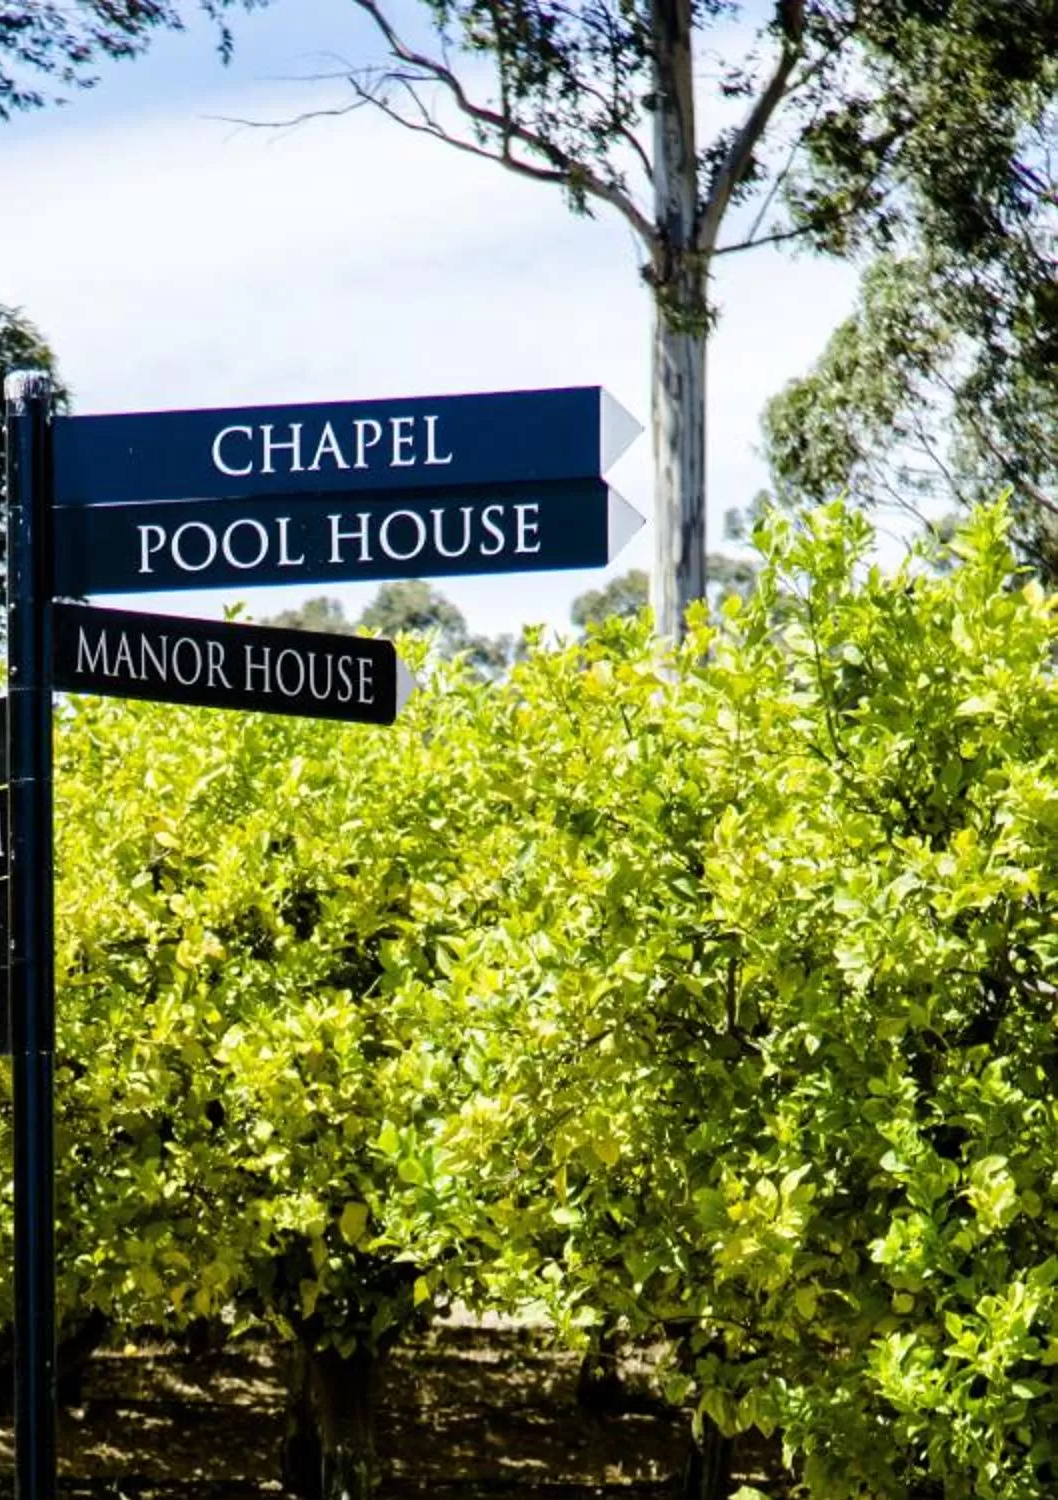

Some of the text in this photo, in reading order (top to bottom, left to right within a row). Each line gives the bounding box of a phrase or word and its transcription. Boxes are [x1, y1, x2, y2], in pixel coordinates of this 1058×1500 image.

[211, 415, 454, 476] CHAPEL
[137, 503, 541, 574] POOL HOUSE
[75, 626, 375, 705] MANOR HOUSE
